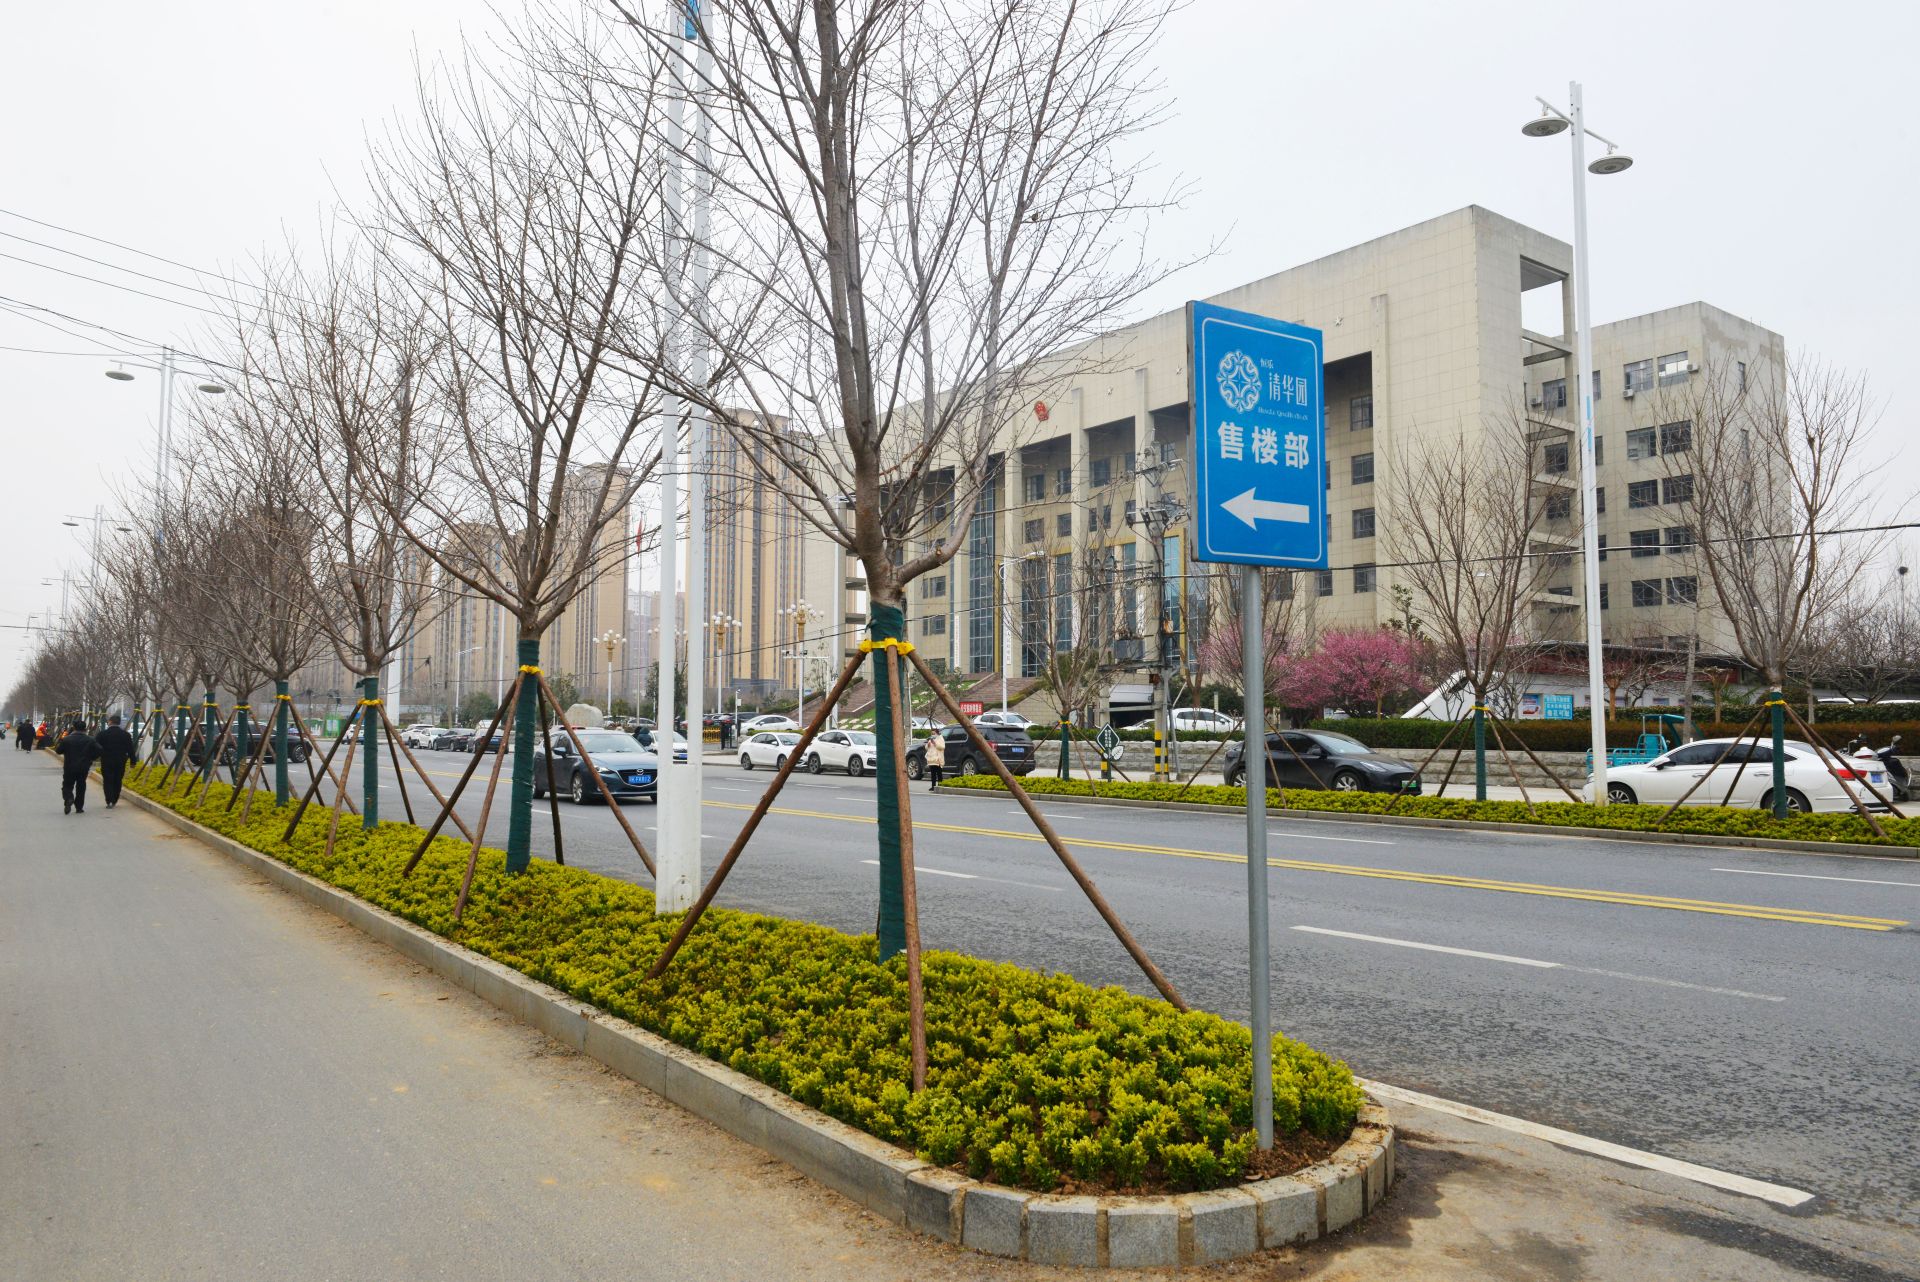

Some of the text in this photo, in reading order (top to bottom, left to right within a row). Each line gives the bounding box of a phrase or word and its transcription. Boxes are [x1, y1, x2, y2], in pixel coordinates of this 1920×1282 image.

[1269, 372, 1307, 406] 清华园
[1217, 420, 1310, 470] 售楼部
